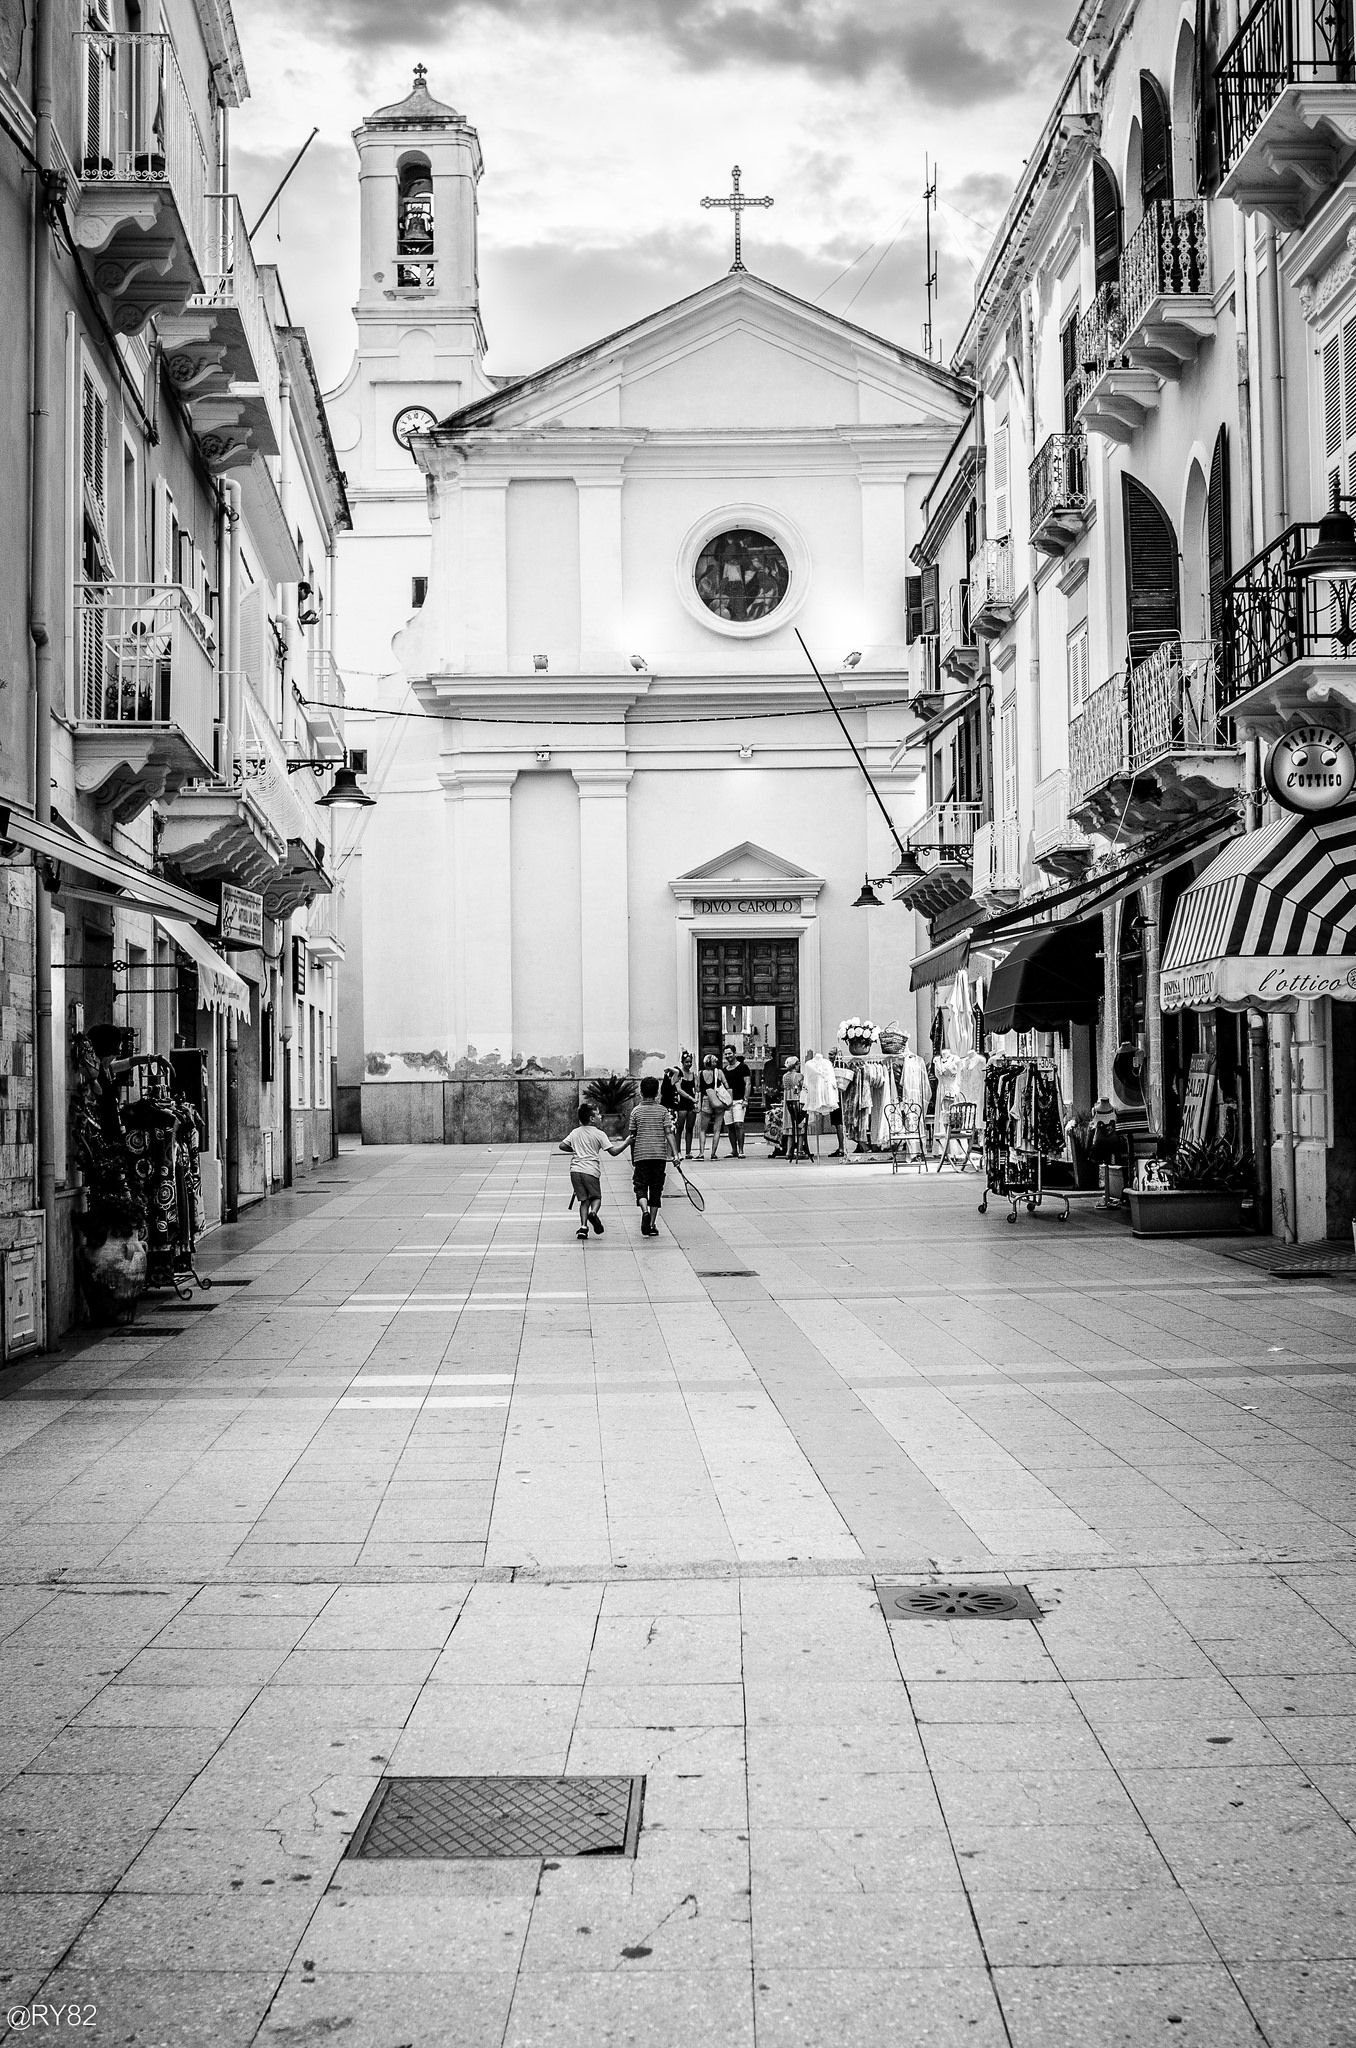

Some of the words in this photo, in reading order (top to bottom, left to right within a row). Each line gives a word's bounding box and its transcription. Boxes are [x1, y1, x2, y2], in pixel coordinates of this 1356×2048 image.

[1282, 728, 1345, 752] PISPISA
[702, 900, 732, 913] DIVO
[737, 900, 793, 913] CAROLO
[1258, 968, 1342, 992] l'ottico
